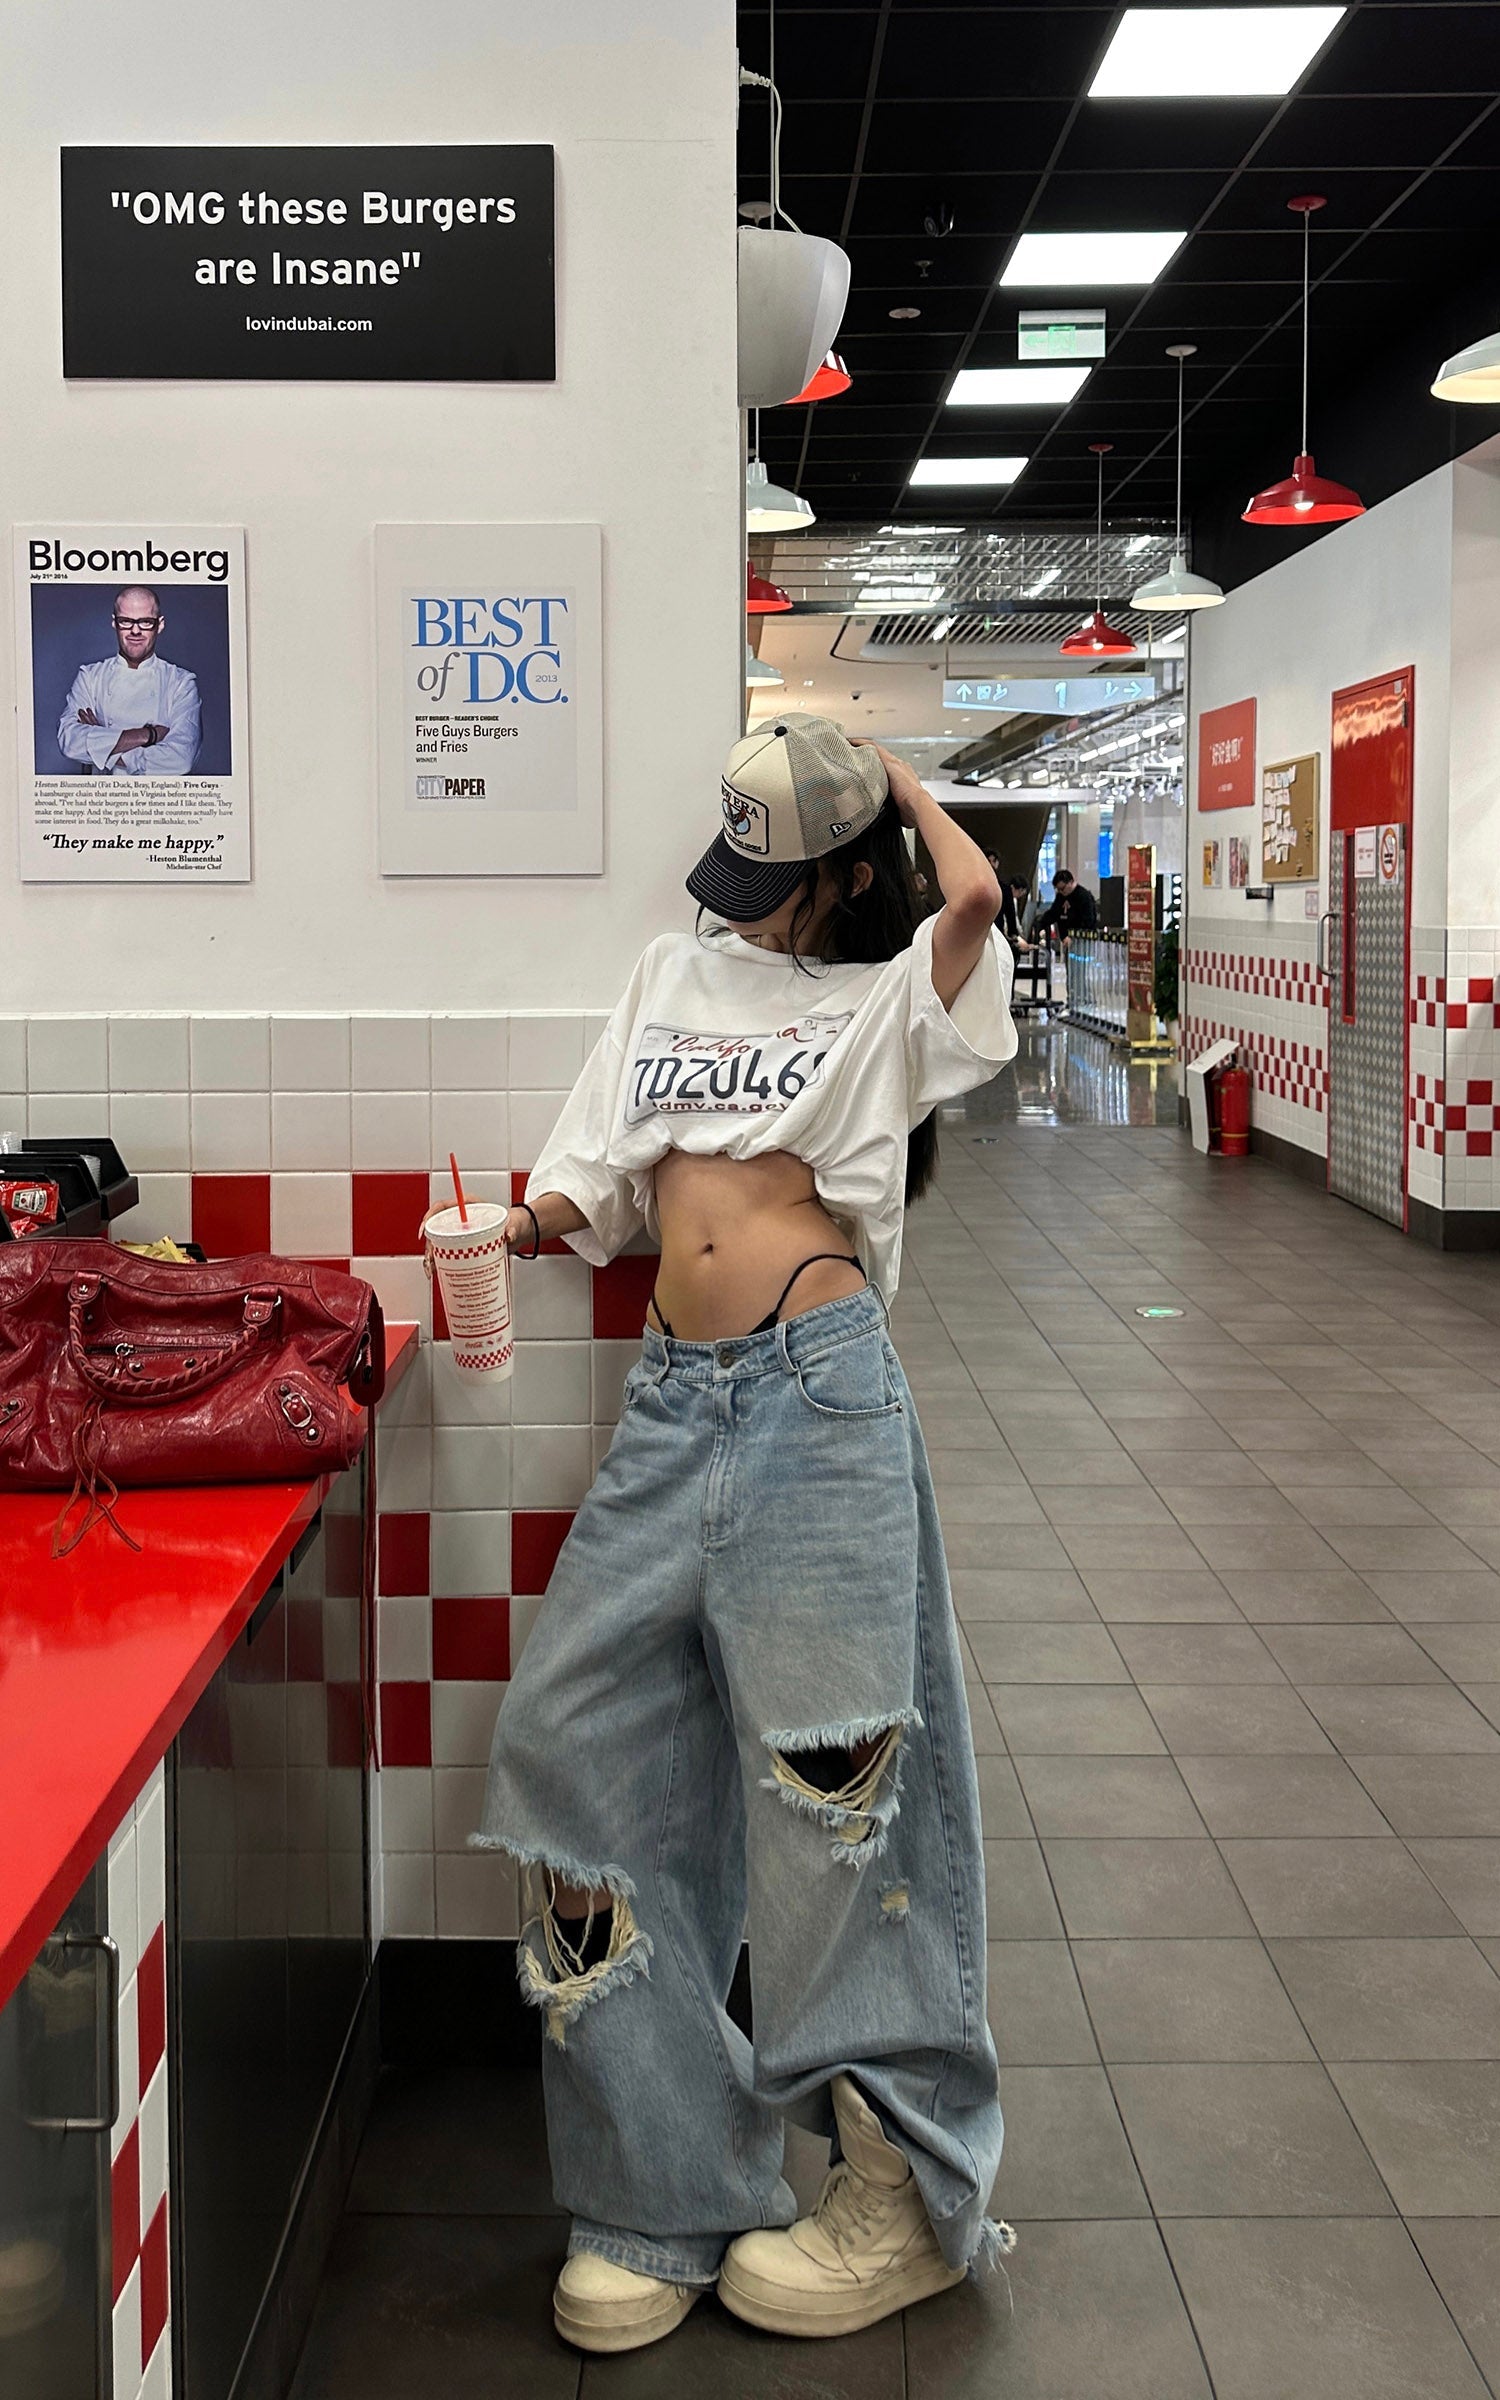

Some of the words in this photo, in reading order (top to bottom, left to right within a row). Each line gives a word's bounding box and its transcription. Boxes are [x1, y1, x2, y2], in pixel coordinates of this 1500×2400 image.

[110, 191, 226, 225] "OMG
[238, 190, 347, 225] these
[363, 191, 517, 233] Burgers
[194, 258, 257, 285] are
[272, 251, 422, 286] Insane"
[245, 315, 373, 332] lovindubai.com
[29, 540, 229, 581] Bloomberg
[410, 597, 569, 648] BEST
[417, 651, 461, 702] of
[462, 650, 569, 704] D.C.
[535, 674, 558, 683] 2013
[416, 724, 439, 737] Five
[441, 724, 471, 740] Guys
[473, 724, 519, 740] Burgers
[416, 740, 438, 753] and
[440, 740, 469, 753] Fries
[113, 781, 132, 789] Duck,
[200, 782, 219, 790] Guys
[39, 790, 74, 798] hamburger
[140, 790, 166, 799] Virginia
[105, 799, 128, 808] burgers
[217, 799, 233, 808] They
[733, 795, 760, 820] ERA
[193, 809, 217, 818] actually
[103, 818, 119, 826] They
[135, 818, 151, 827] great
[43, 834, 89, 853] “They
[91, 834, 134, 849] make
[137, 838, 161, 849] me
[165, 834, 225, 854] happy.”
[145, 855, 177, 863] -Heston
[178, 855, 222, 863] Blumenthal
